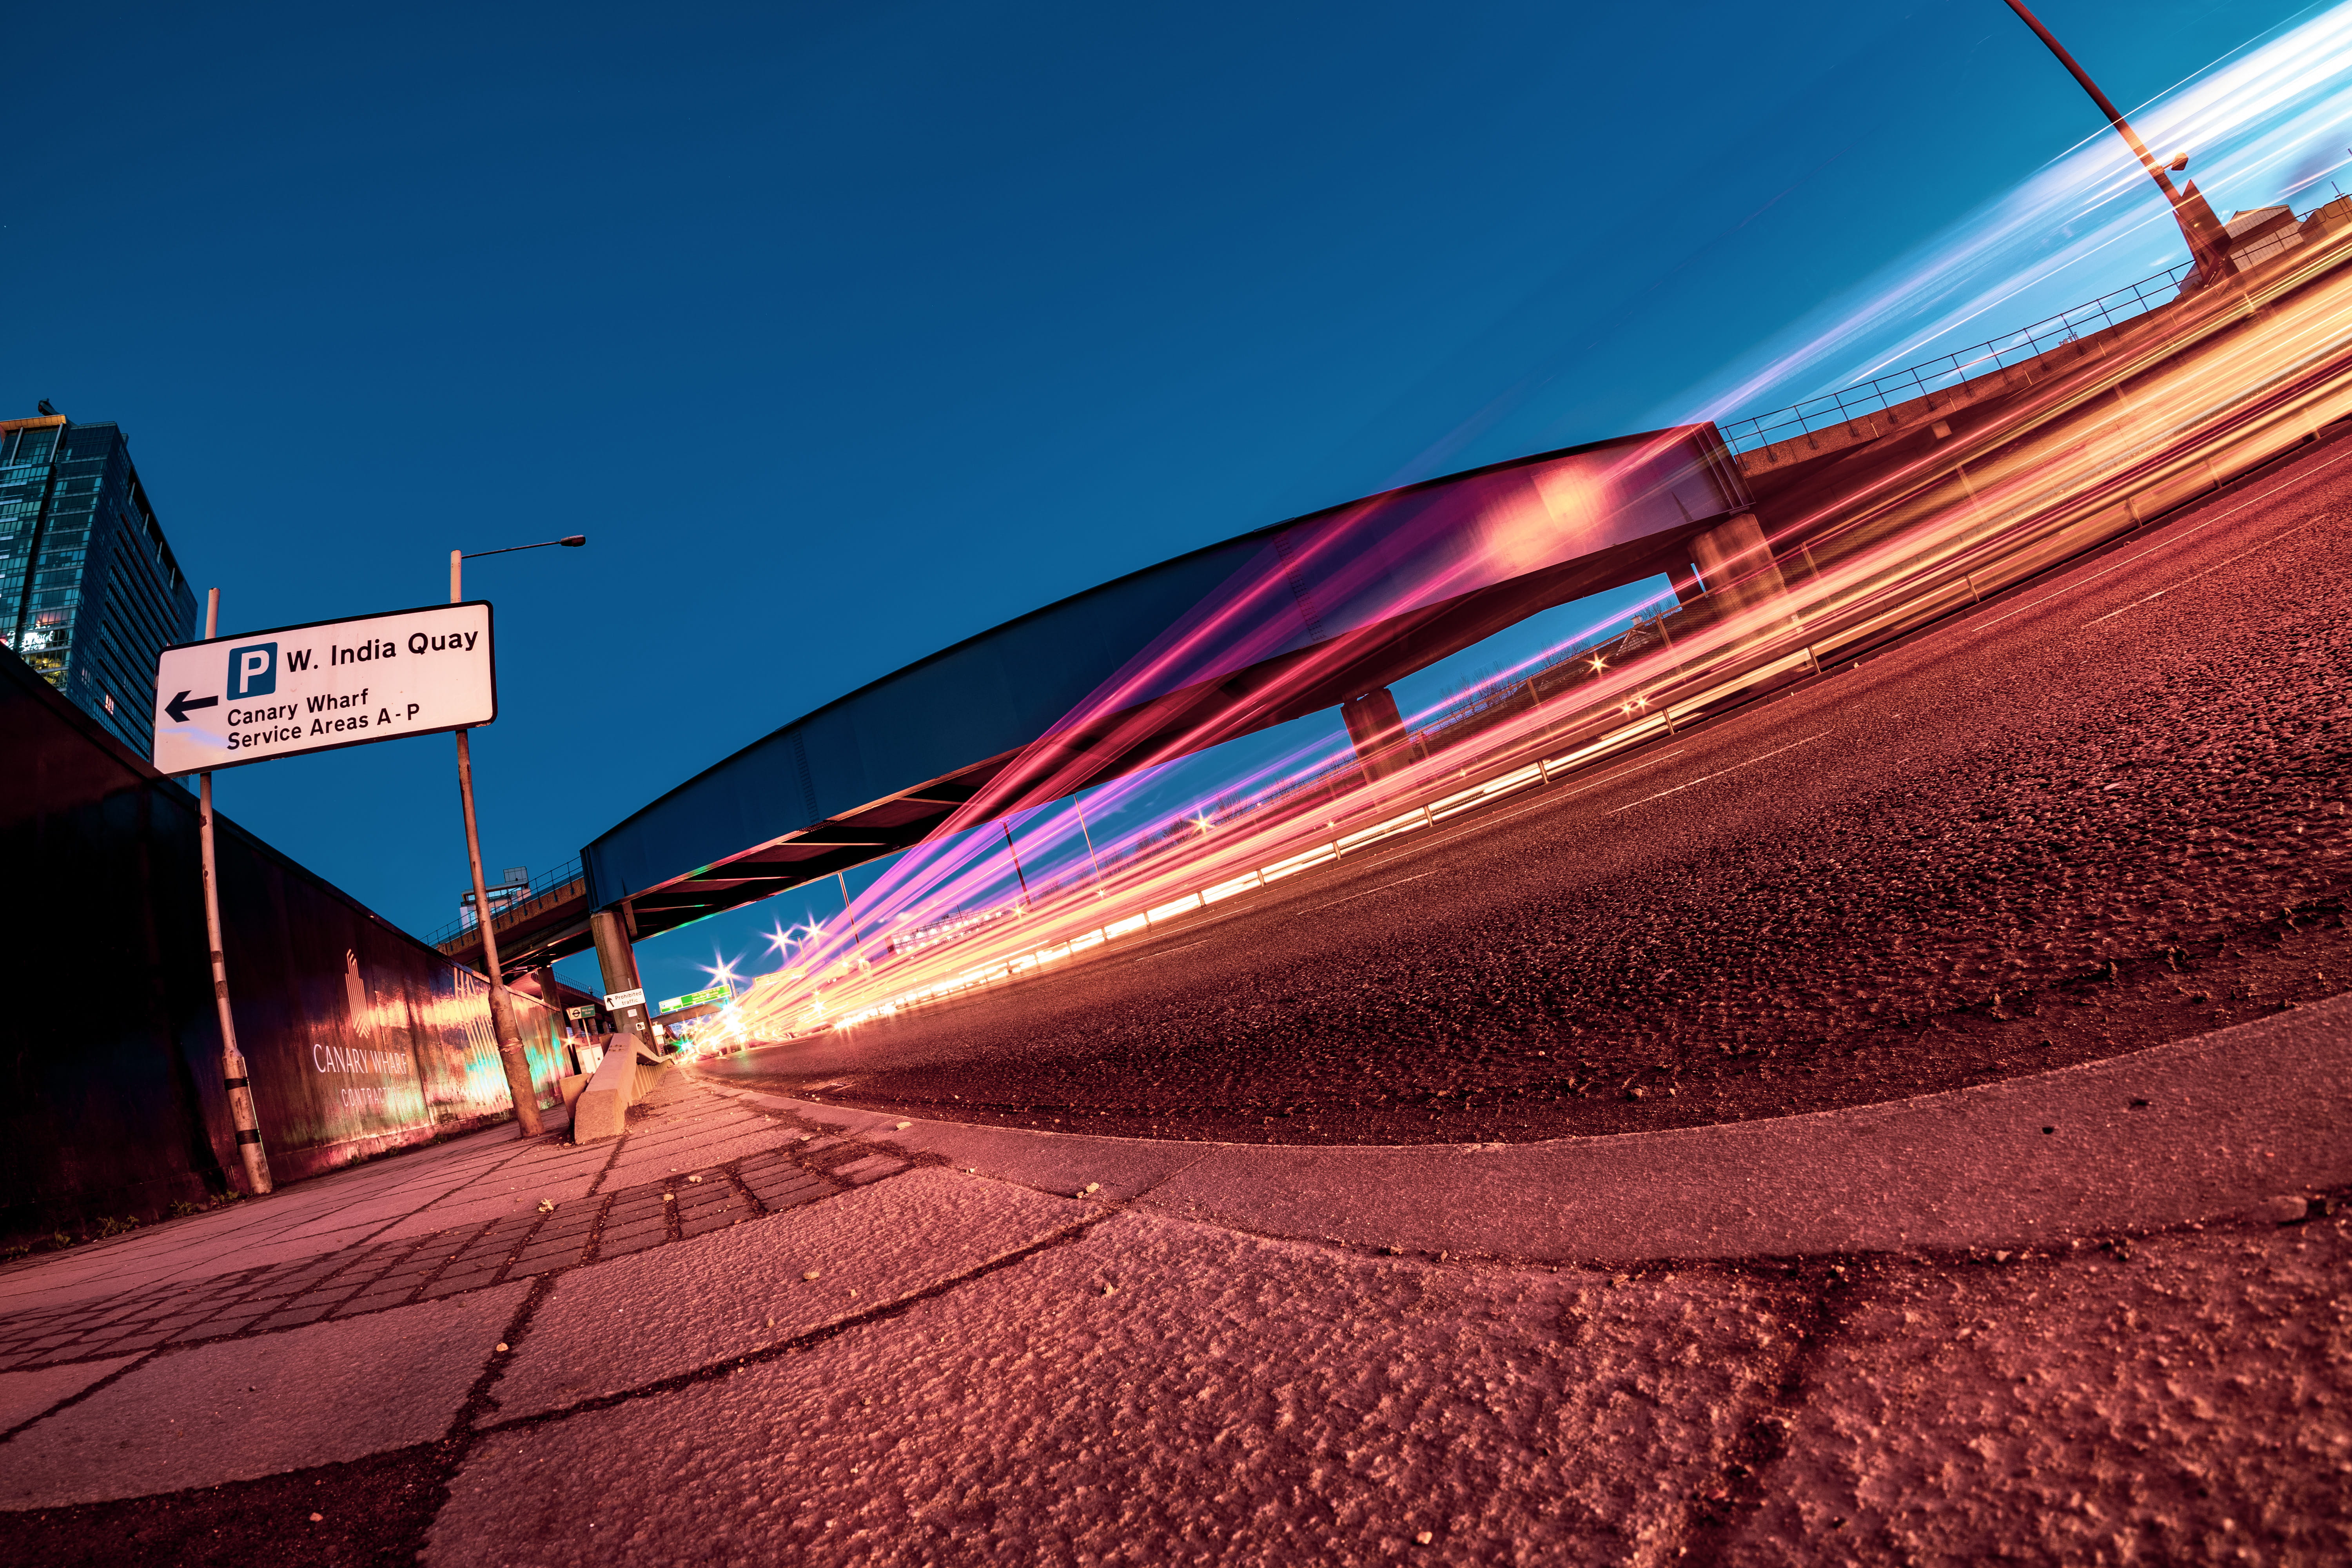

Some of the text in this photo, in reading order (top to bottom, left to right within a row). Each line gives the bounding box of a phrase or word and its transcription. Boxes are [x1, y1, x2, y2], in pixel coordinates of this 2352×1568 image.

[287, 631, 478, 673] W. India Quay
[239, 650, 270, 693] P
[227, 688, 368, 726] Canary Wharf
[227, 726, 301, 750] Service
[310, 715, 368, 736] Areas
[615, 991, 642, 1000] Prohibited
[314, 1044, 408, 1074] CANARY WHARF
